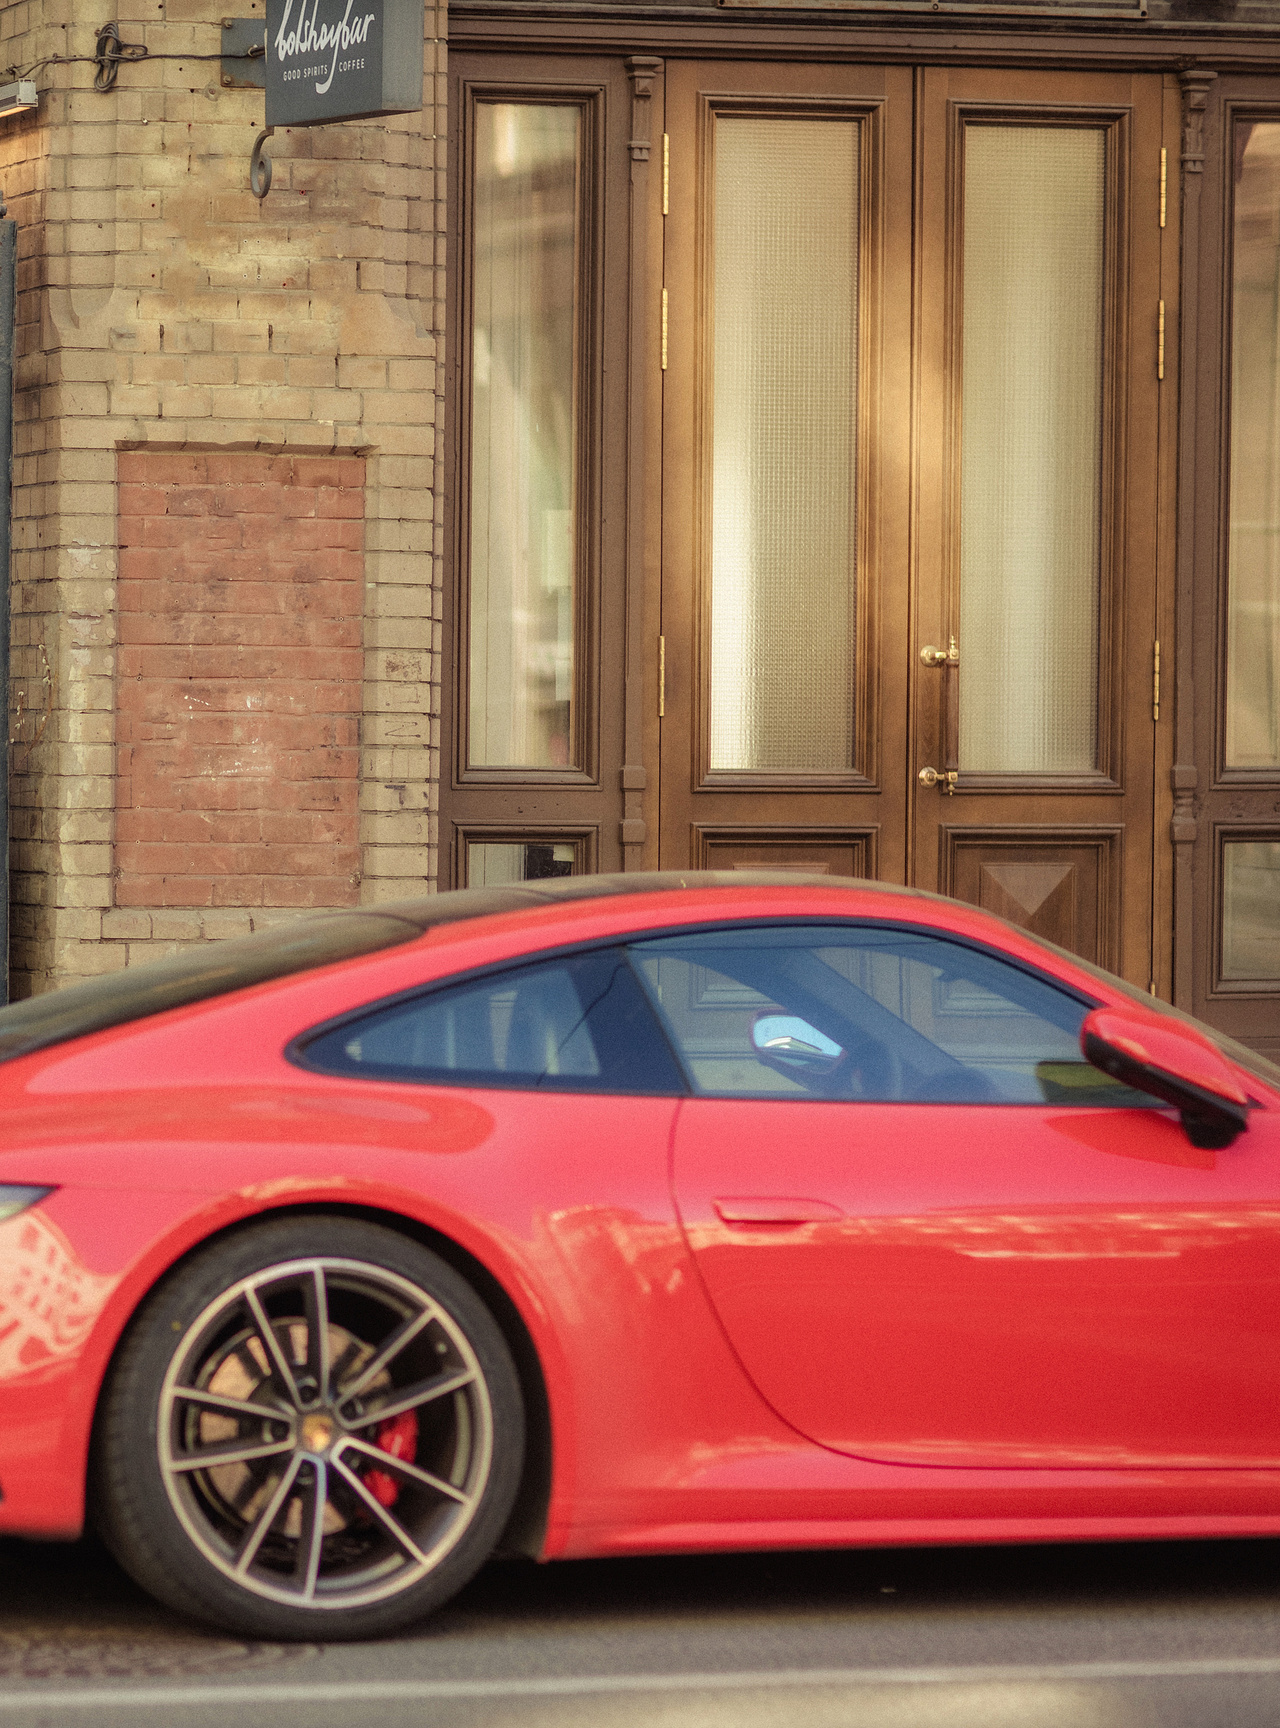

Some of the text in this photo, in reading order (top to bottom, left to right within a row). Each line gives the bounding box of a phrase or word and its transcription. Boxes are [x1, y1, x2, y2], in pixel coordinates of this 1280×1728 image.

[283, 58, 365, 81] GOOD SPIRITS COFFEE
